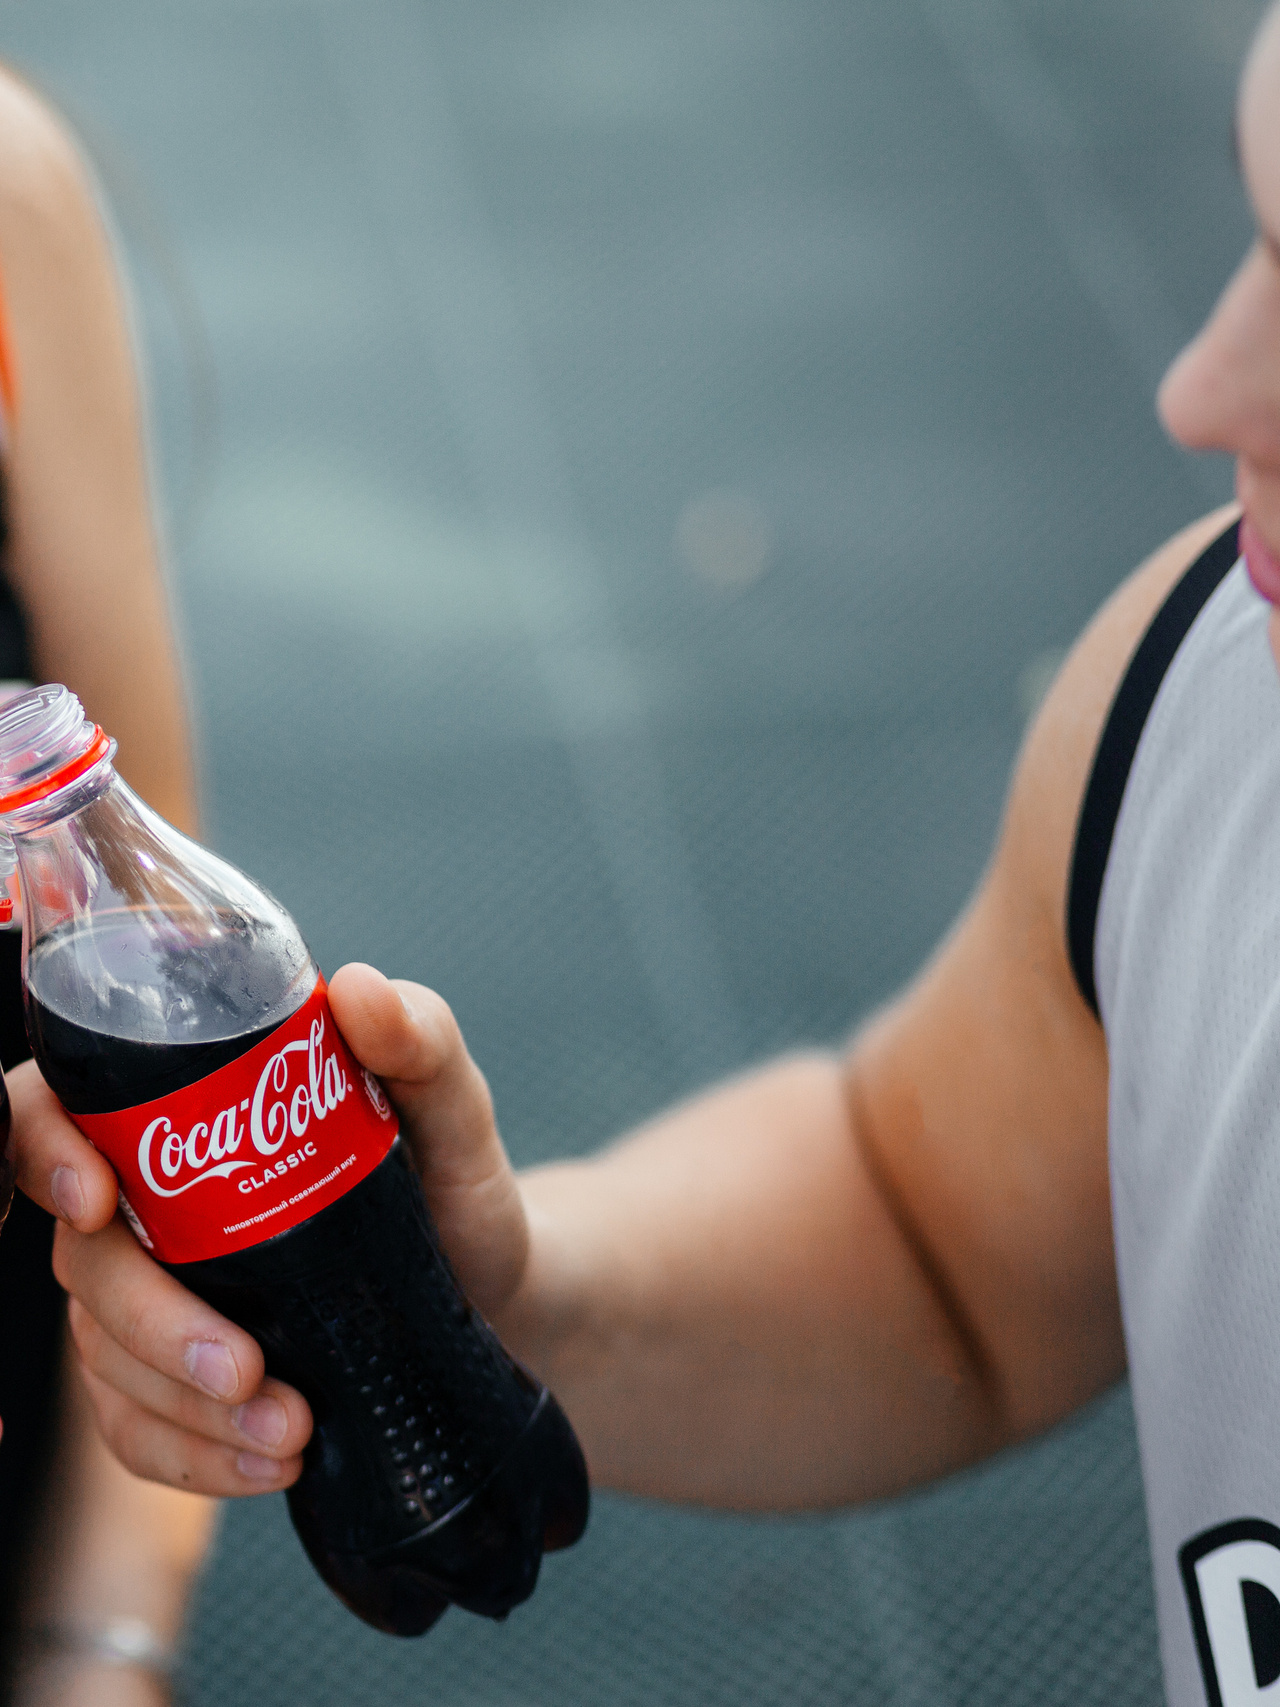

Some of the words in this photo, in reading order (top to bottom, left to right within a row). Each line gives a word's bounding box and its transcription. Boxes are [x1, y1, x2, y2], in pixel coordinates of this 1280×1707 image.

[138, 1011, 348, 1197] Coca-Cola
[223, 1200, 289, 1235] Неповторимый
[288, 1166, 342, 1205] освежающий
[238, 1141, 318, 1194] CLASSIC
